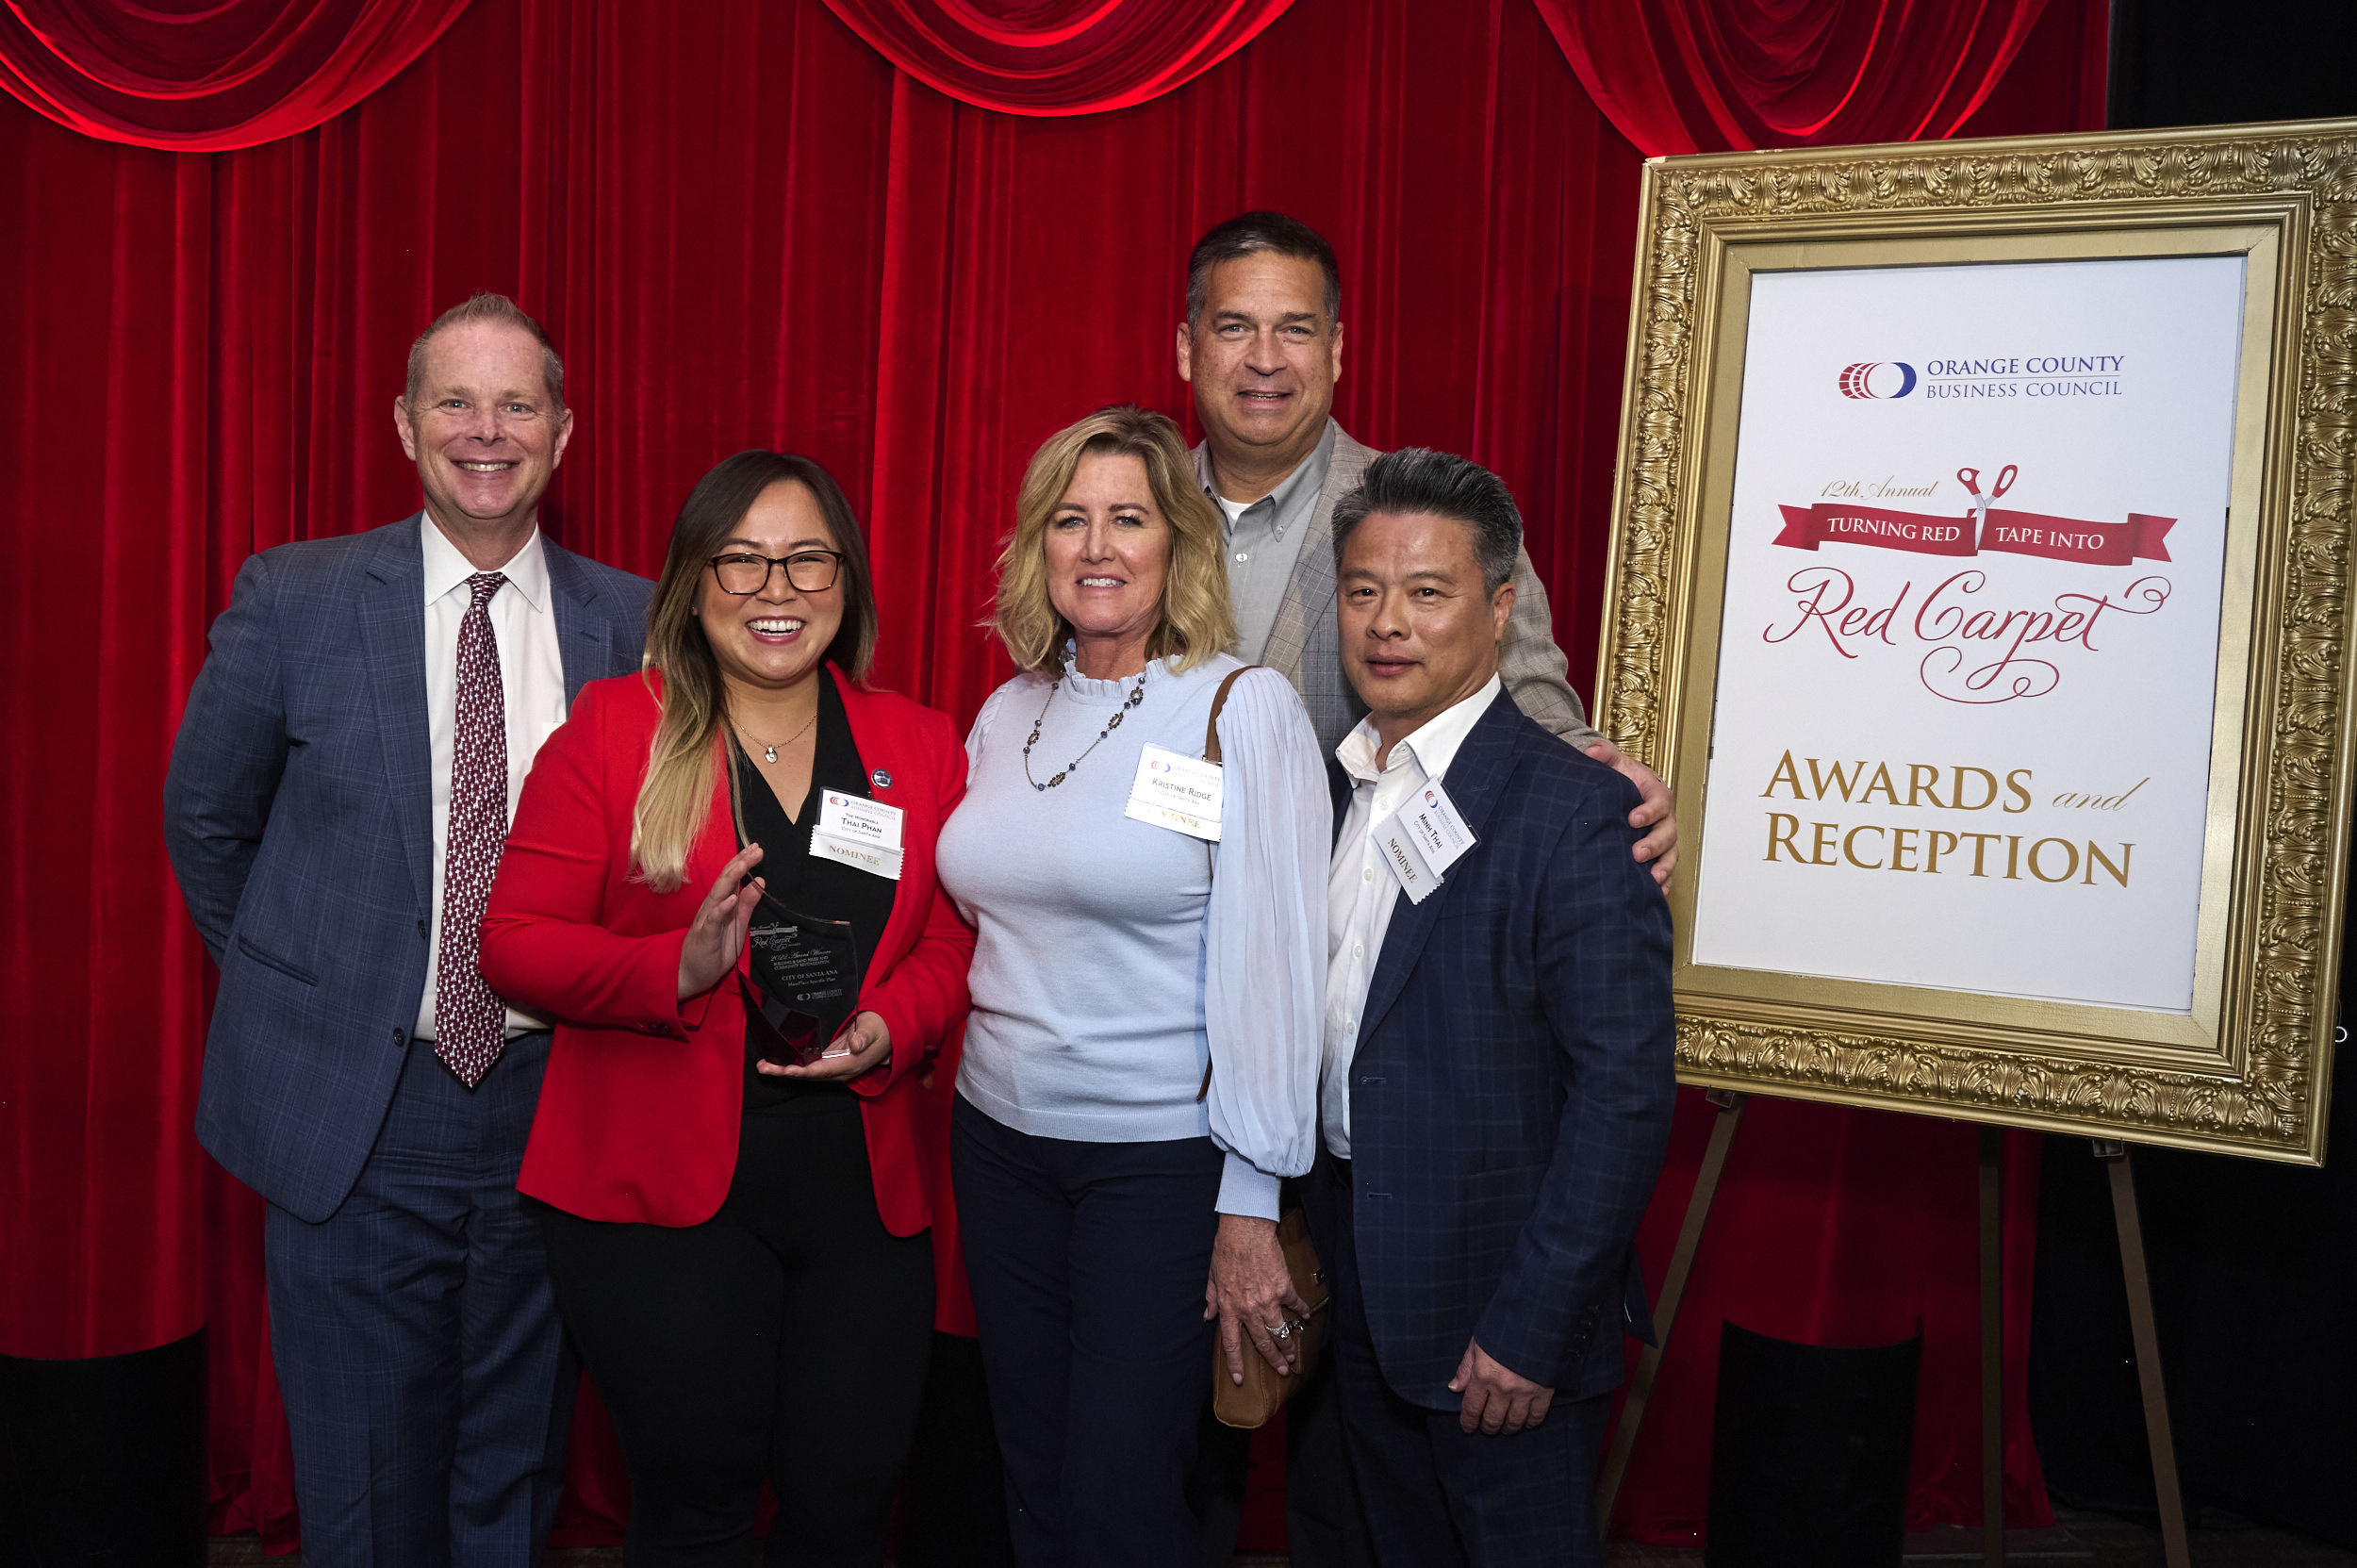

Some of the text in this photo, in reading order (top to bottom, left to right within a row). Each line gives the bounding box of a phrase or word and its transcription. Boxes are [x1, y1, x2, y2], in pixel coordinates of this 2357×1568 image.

[1927, 355, 2125, 376] ORANGE COUNTY
[1926, 379, 2122, 399] BUSINESS COUNCIL
[1861, 474, 1939, 500] Annual
[1826, 517, 2104, 551] TURNING RED TAPE INTO
[1763, 567, 2172, 704] Red Carpet
[1152, 778, 1187, 794] KRISTINE
[1188, 787, 1212, 801] RIDGE
[1758, 749, 2151, 814] AWARDS and
[850, 800, 897, 816] ORANGE COUNTY
[841, 817, 882, 834] THAI PHAN
[1418, 813, 1443, 849] MINH THAI
[829, 845, 881, 866] NOMINEE
[1387, 837, 1418, 883] NOMINEE
[1762, 812, 2136, 888] RECEPTION
